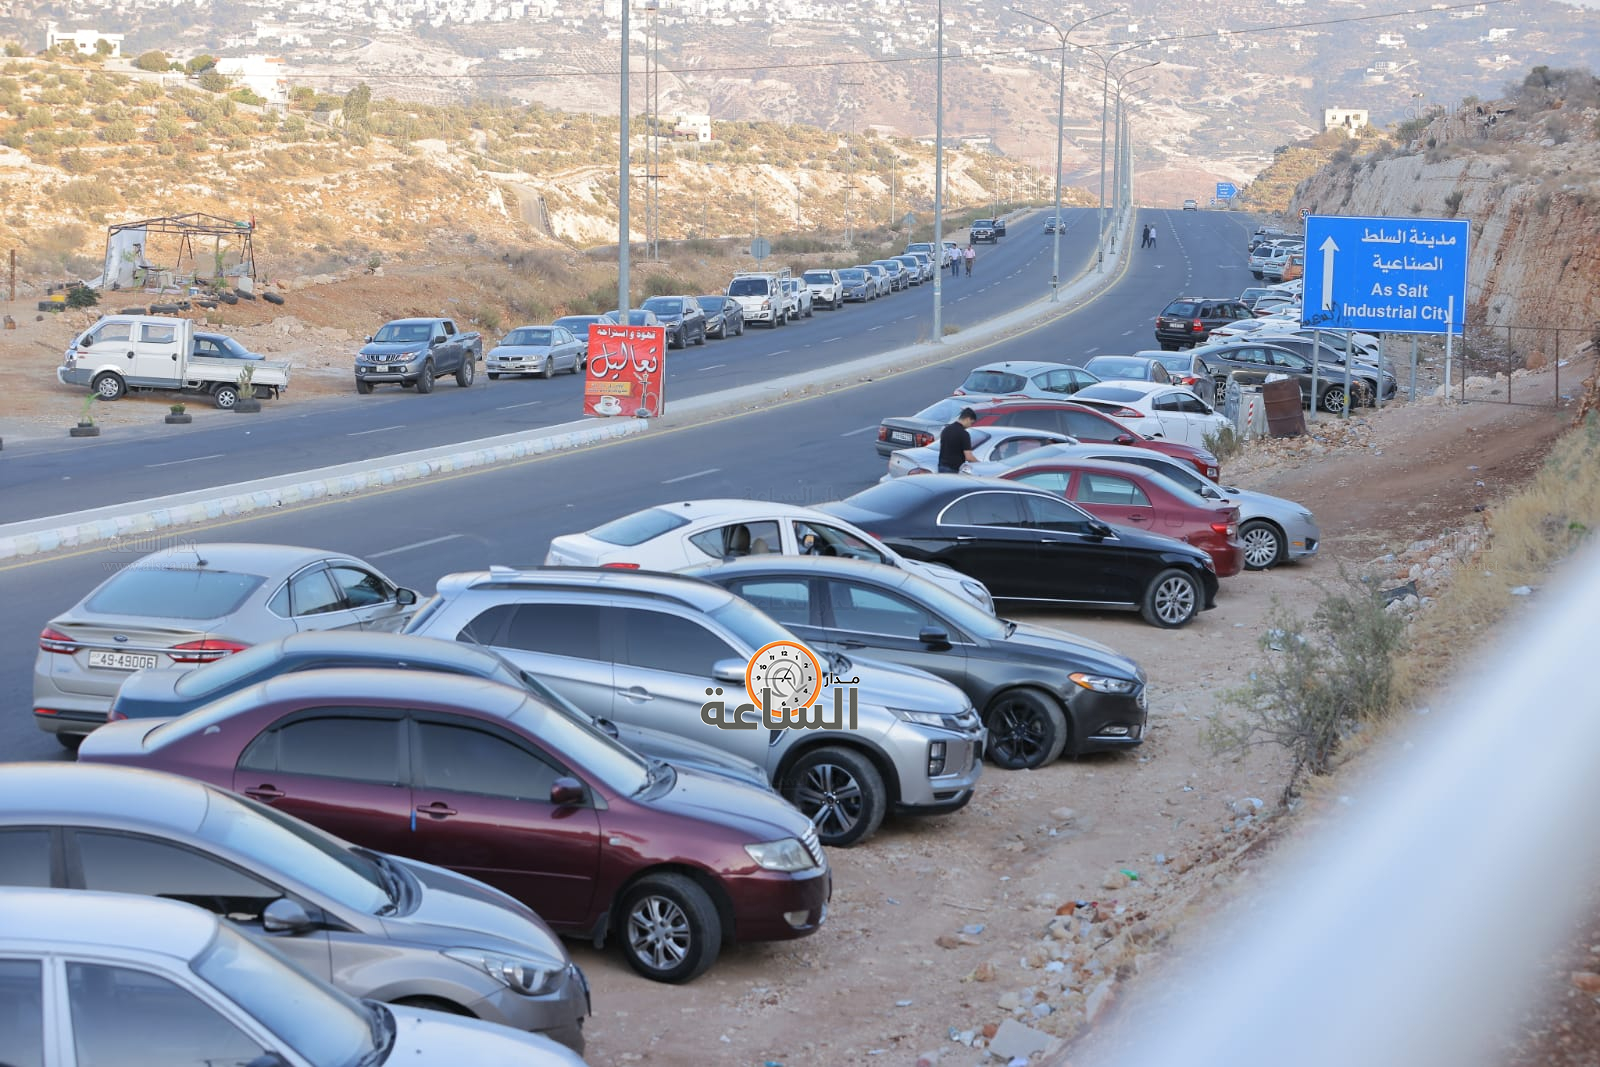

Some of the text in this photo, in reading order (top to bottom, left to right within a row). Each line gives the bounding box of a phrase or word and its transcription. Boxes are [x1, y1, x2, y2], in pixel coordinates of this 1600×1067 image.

[1361, 228, 1456, 249] مدينة السلط
[1373, 254, 1443, 273] الصناعية
[1371, 283, 1429, 298] As Salt
[1343, 303, 1417, 319] Industrial
[1421, 306, 1450, 324] City
